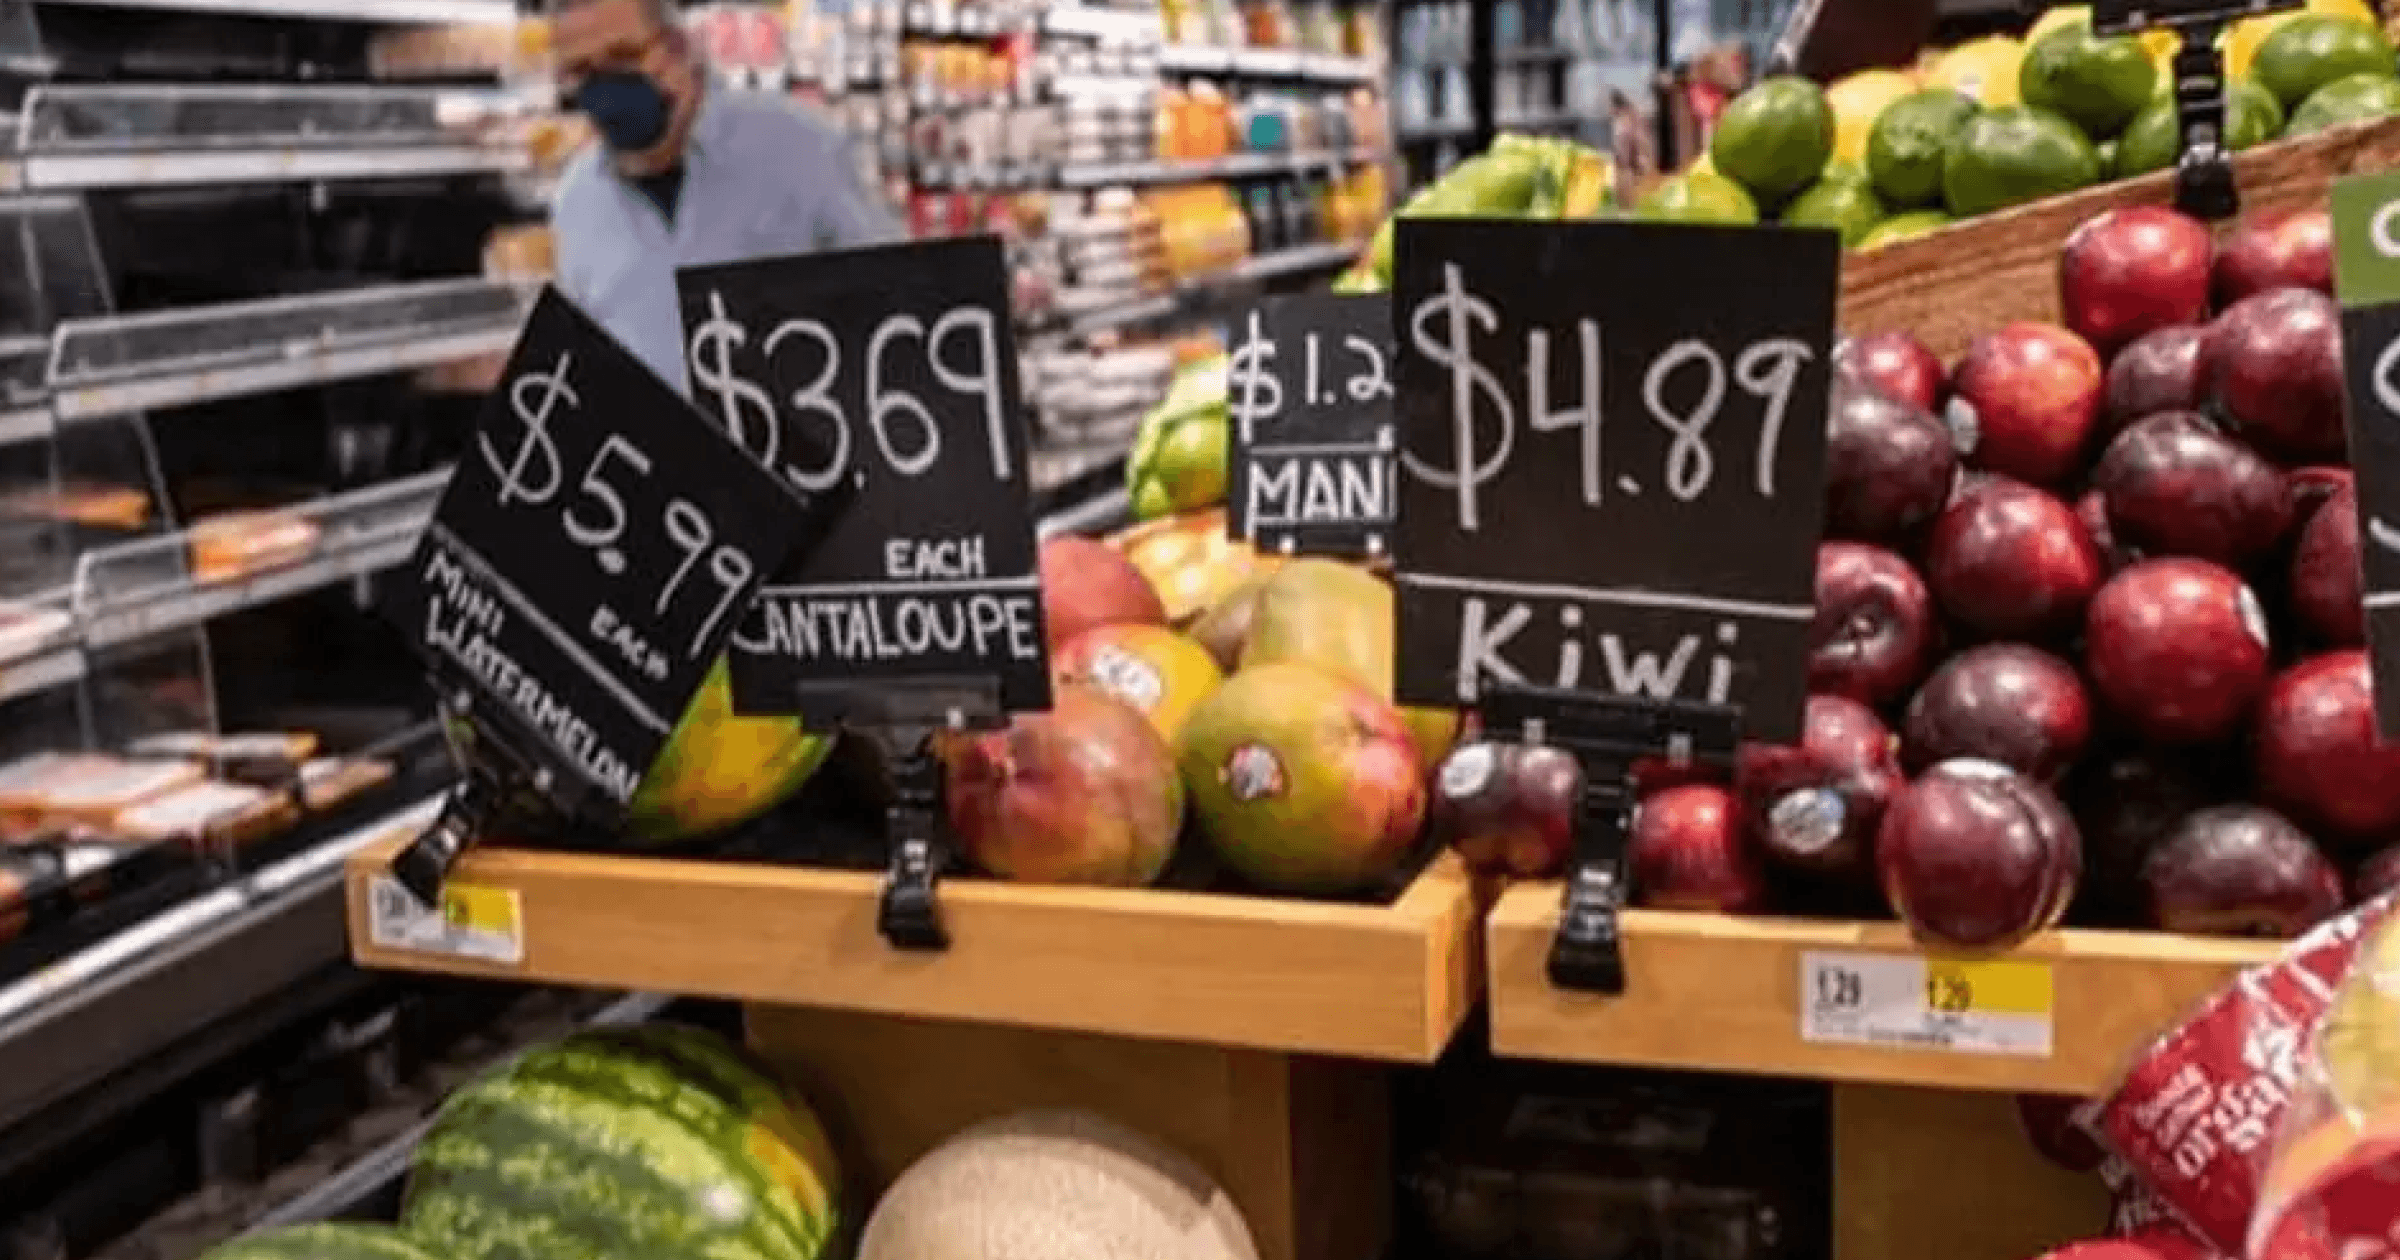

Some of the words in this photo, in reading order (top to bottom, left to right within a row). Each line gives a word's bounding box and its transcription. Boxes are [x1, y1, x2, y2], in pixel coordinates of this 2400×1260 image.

[691, 290, 1011, 491] $3.69
[1230, 308, 1397, 444] $1.2
[1401, 261, 1815, 531] $4.89
[475, 350, 753, 660] $5.99
[884, 534, 985, 578] EACH
[1246, 455, 1397, 526] MAN
[425, 549, 505, 636] MINI
[1457, 598, 1739, 704] Kiwi
[425, 596, 641, 804] WATERMELON
